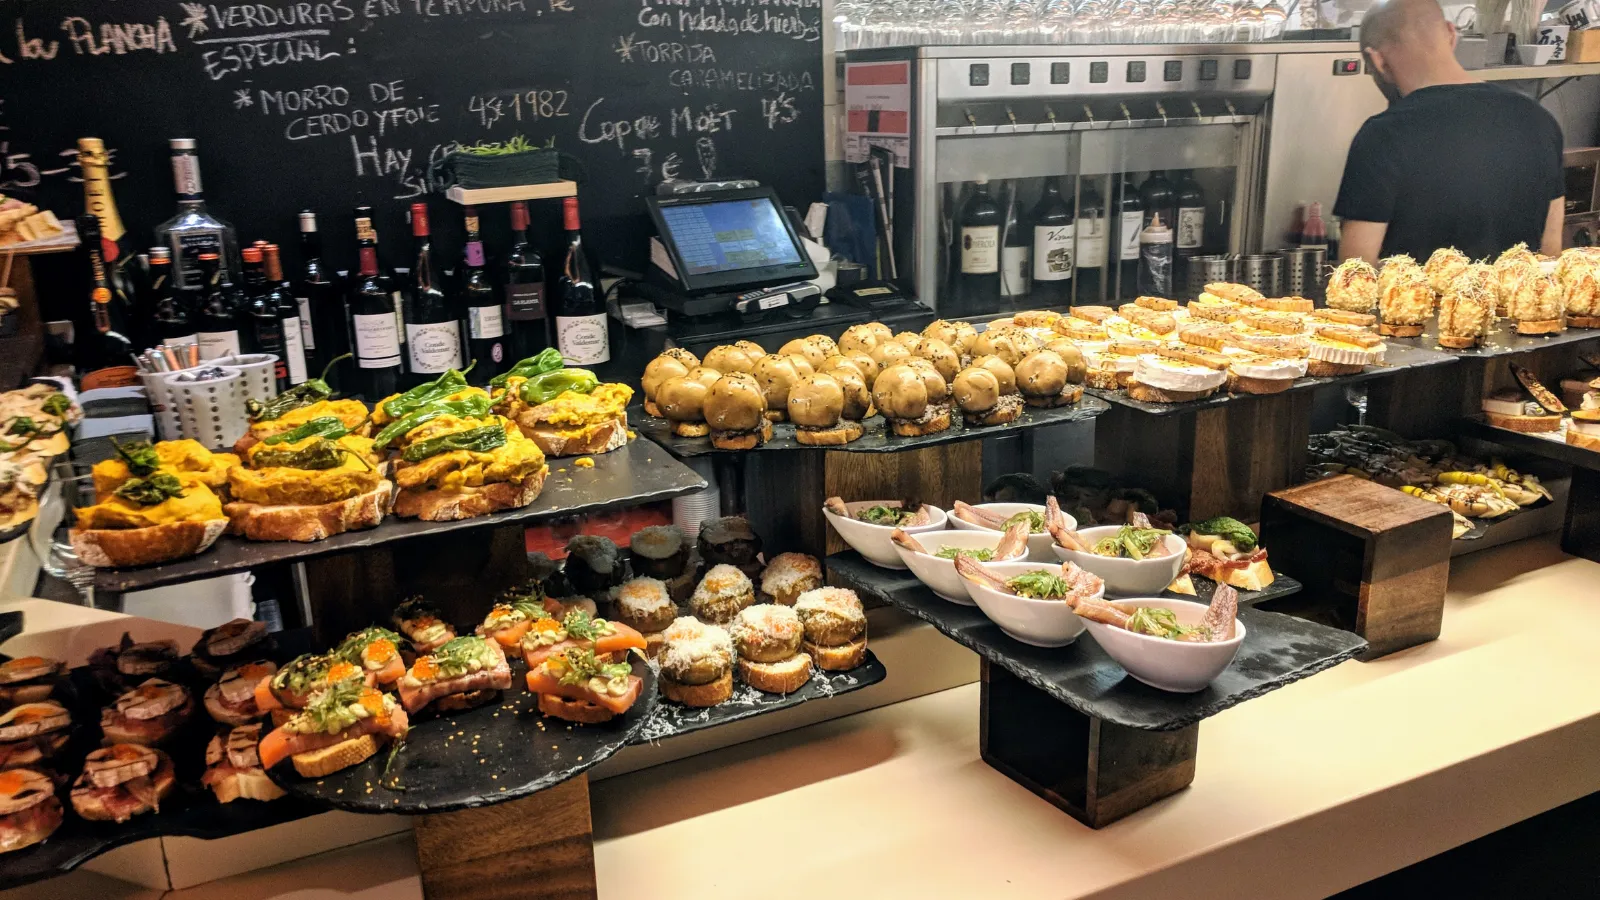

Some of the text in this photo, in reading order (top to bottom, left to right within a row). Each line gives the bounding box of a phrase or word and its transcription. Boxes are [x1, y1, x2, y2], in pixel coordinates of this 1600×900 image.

[208, 0, 354, 29] VERDURAS
[634, 40, 717, 63] TORRIJA
[259, 80, 405, 116] MORRO DE
[285, 109, 369, 140] CERDO
